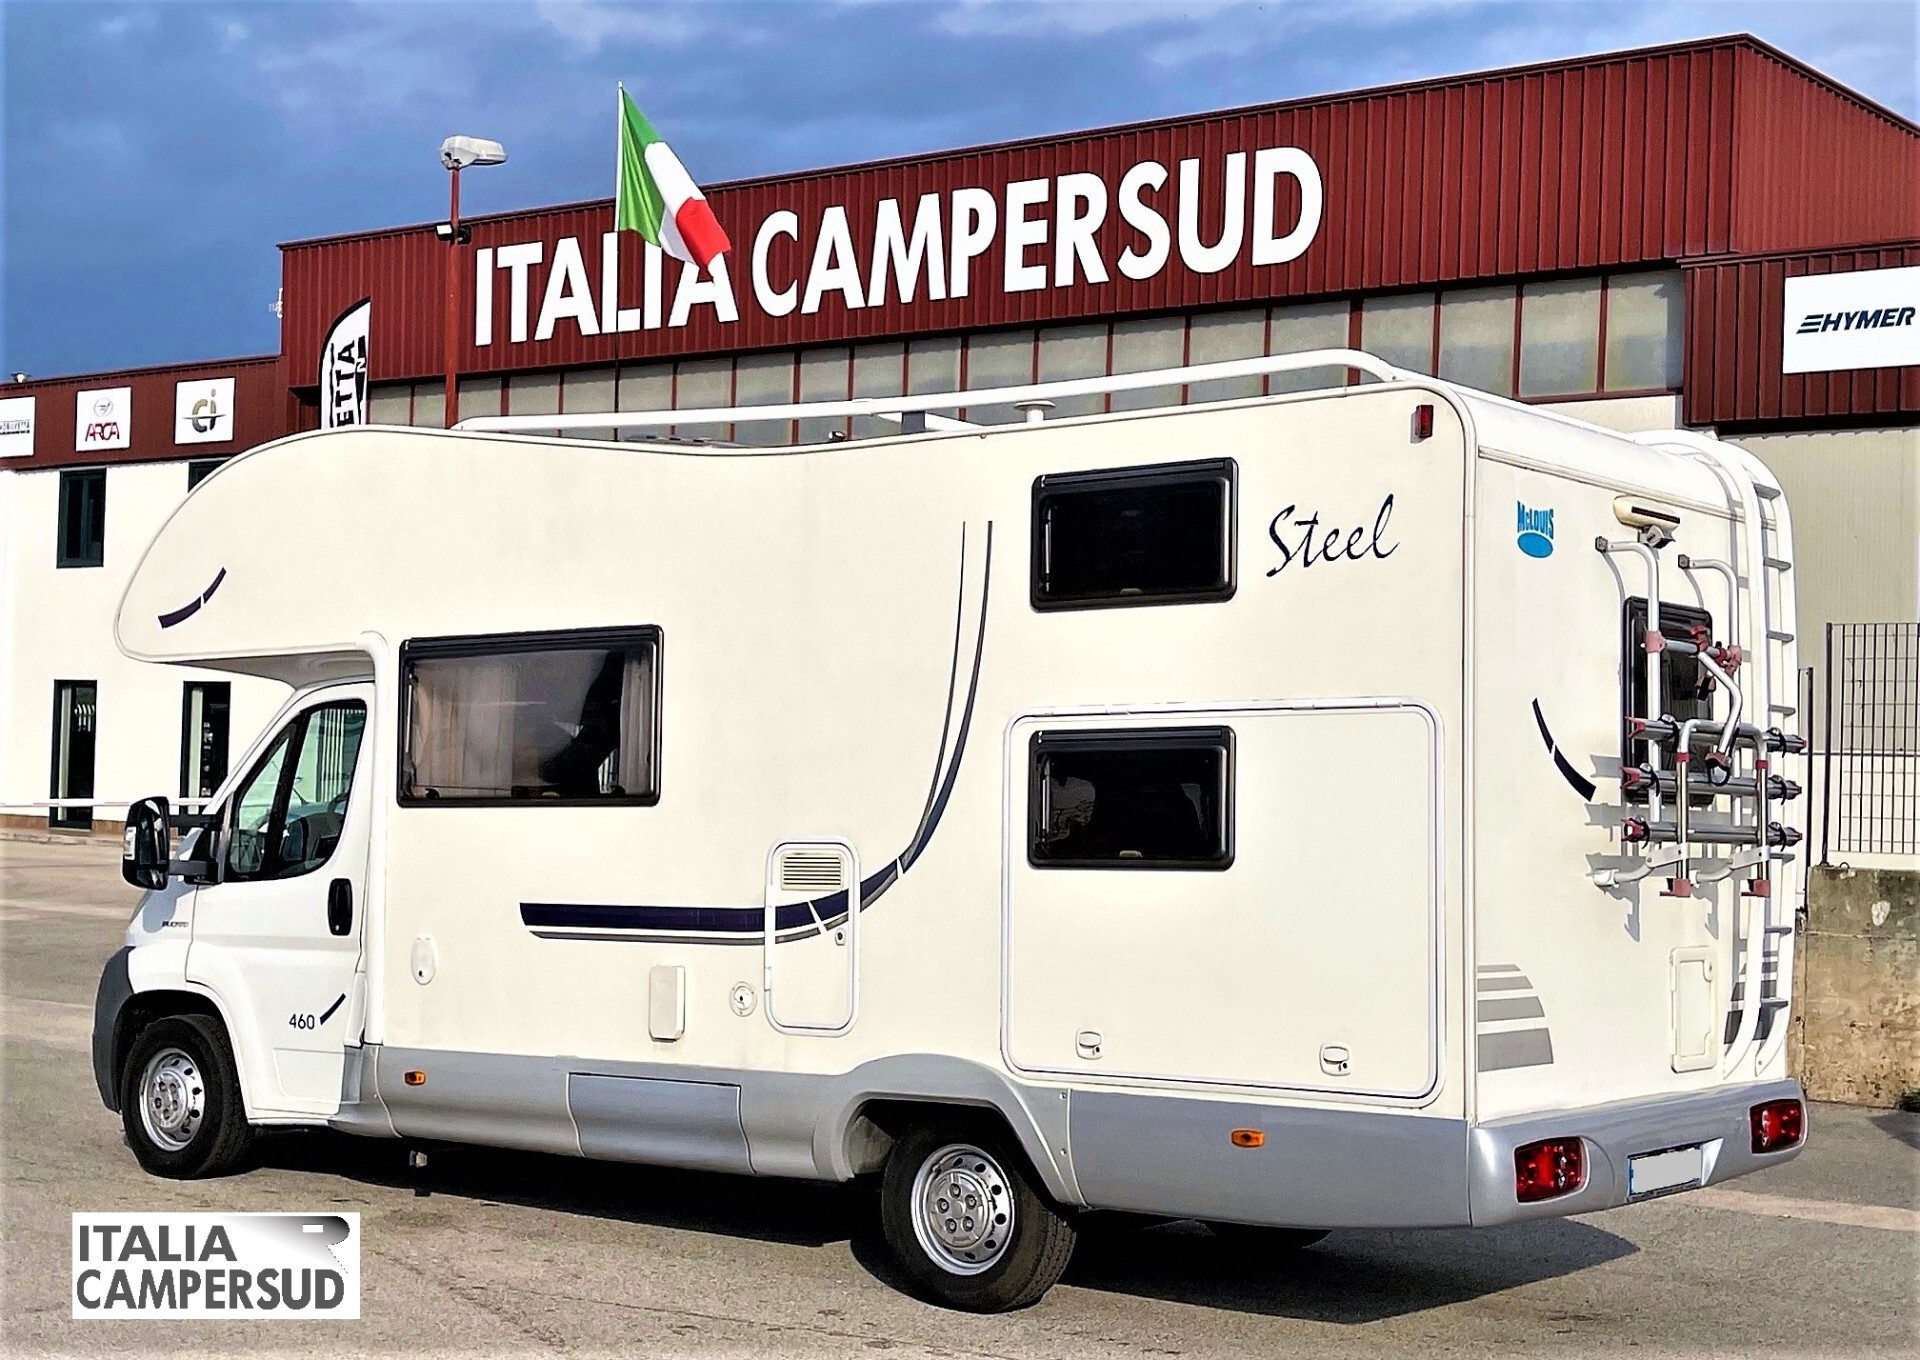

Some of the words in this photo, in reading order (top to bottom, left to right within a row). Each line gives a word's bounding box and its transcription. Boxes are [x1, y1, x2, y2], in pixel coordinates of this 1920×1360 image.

[475, 229, 739, 346] ITALIA
[752, 147, 1323, 317] CAMPERSUD
[1820, 306, 1916, 333] HYMER
[85, 421, 120, 442] ARCA
[1266, 493, 1400, 578] Steel
[289, 1013, 315, 1030] 460
